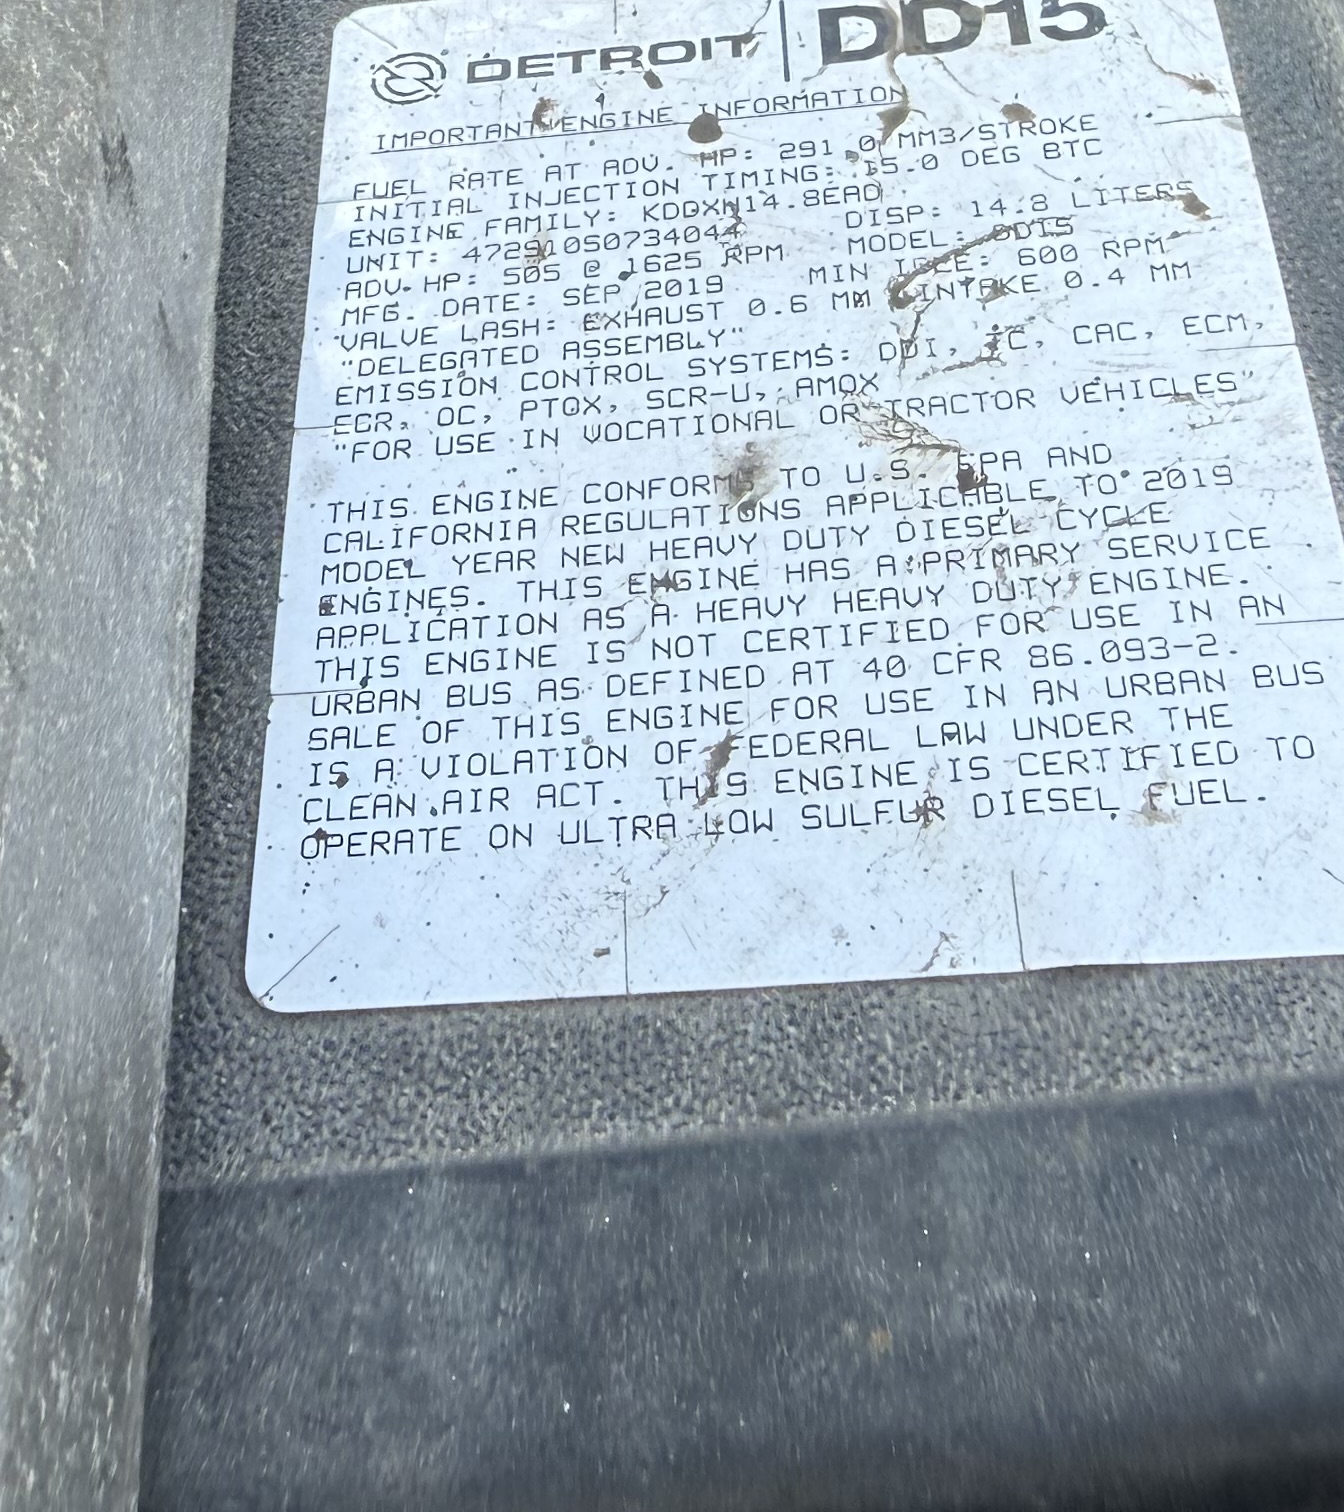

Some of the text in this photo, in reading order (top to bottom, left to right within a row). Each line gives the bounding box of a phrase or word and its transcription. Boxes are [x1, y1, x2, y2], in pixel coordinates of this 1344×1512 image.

[466, 34, 760, 85] DETROIT
[353, 177, 428, 201] FUEL
[448, 167, 523, 191] RATE
[544, 162, 581, 182] AT
[602, 153, 675, 177] ADV.
[699, 145, 753, 168] HP:
[897, 112, 1100, 149] MM3/STROKE
[375, 82, 908, 151] IMPORTANT ENGINE INFORMATION
[354, 195, 484, 224] INITIAL
[508, 176, 679, 210] INJECTION
[701, 162, 835, 192] TIMING:
[960, 144, 1022, 167] DEG
[1042, 137, 1104, 160] BTC
[347, 248, 439, 274] UNIT:
[844, 202, 942, 229] DISP:
[969, 193, 1050, 218] 14.8
[1071, 179, 1198, 209] LITERS
[348, 220, 463, 248] ENGINE
[484, 207, 617, 237] FAMILY:
[502, 262, 560, 286] 505
[582, 259, 600, 279] @
[625, 250, 702, 275] 1625
[723, 242, 783, 266] RPM
[846, 226, 967, 255] MODEL:
[340, 260, 1194, 353] VALUE LASH: EXHAUST 0.6 MM INTAKE 0.4 MM
[342, 301, 417, 326] MFG.
[442, 290, 536, 317] DATE:
[562, 283, 621, 307] SEP
[643, 274, 723, 300] 2019
[807, 261, 869, 286] MIN
[1016, 242, 1081, 267] 600
[1101, 233, 1166, 258] RPM
[336, 374, 498, 407] EMISSION
[520, 360, 664, 392] CONTROL
[686, 344, 851, 378] SYSTEMS:
[1071, 319, 1156, 348] CAC,
[1181, 309, 1268, 338] ECM,
[435, 431, 496, 456] USE
[521, 426, 559, 449] IN
[582, 407, 795, 445] VOCATIONAL
[817, 402, 860, 426] OR
[882, 387, 1037, 420] TRACTOR
[436, 402, 493, 429] OC,
[519, 392, 618, 422] PTOX,
[646, 380, 768, 412] SCR-U,
[323, 463, 1237, 554] CALIFORNIA REGULATIONS APPLICABLE TO 2019
[326, 496, 409, 523] THIS
[432, 485, 558, 516] ENGINE
[582, 470, 755, 505] CONFORMS
[778, 464, 821, 489] TO
[844, 457, 929, 485] U.S.
[1046, 442, 1115, 468] AND
[319, 526, 1274, 617] ENGINES. THIS ENGINE HAS A PRIMARY SERVICE
[321, 500, 1173, 585] MODEL YEAR NEW HEAVY DUTY DIESEL CYCLE
[314, 592, 1288, 683] THIS ENGINE IS NOT CERTIFIED FOR USE IN AN
[316, 560, 1252, 650] APPLICATION AS A HEAVY HEAVY DUTY ENGINE.
[308, 660, 1329, 752] SALE OF THIS ENGINE FOR USE IN AN URBAN BUS
[311, 630, 1242, 717] URBAN BUS AS DEFINED AT 40 CFR 86.093-2.
[303, 791, 417, 823] CLEAN
[442, 785, 510, 815] AIR
[535, 778, 623, 809] ACT.
[773, 760, 918, 795] ENGINE
[945, 754, 992, 783] IS
[1016, 738, 1243, 778] CERTIFIED
[1266, 733, 1319, 762] TO
[309, 760, 351, 787] IS
[374, 757, 396, 783] A
[420, 742, 627, 780] VIOLATION
[653, 738, 698, 766] OF
[914, 719, 987, 749] LAW
[1011, 709, 1135, 742] UNDER
[1158, 702, 1235, 732] THE
[300, 775, 1270, 860] OPERATE ON ULTRA LOW SULFUR DIESEL FUEL.
